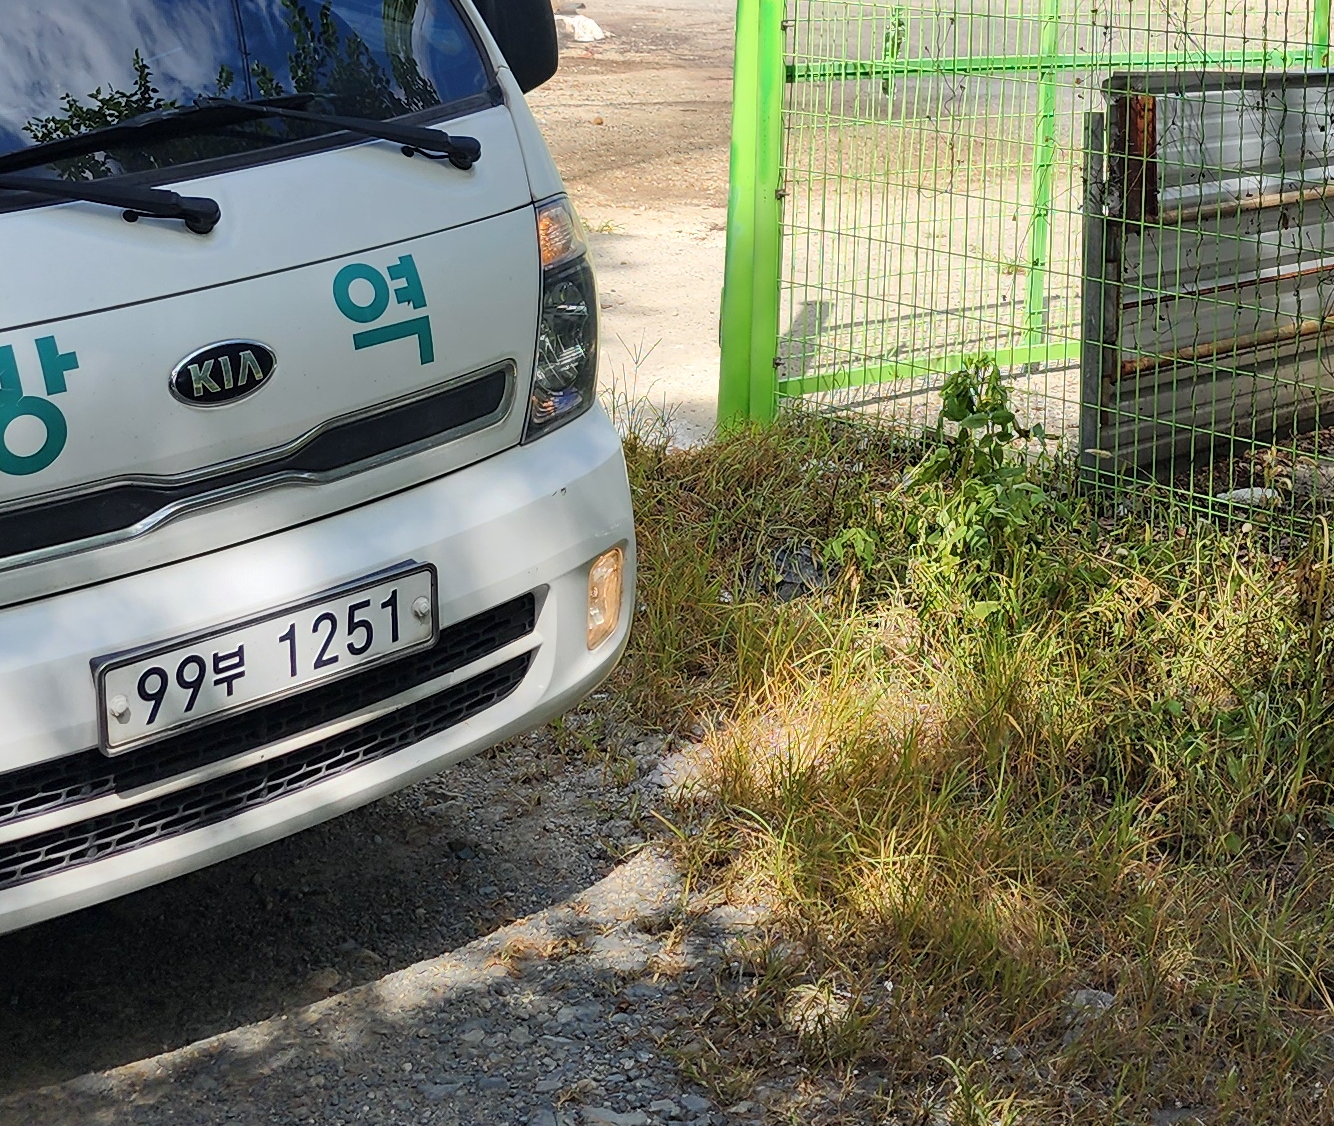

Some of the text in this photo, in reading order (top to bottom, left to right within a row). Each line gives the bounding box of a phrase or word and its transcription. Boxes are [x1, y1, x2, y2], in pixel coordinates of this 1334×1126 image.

[332, 254, 435, 365] 역
[189, 350, 264, 397] KIA
[137, 588, 400, 725] 99부 1251
